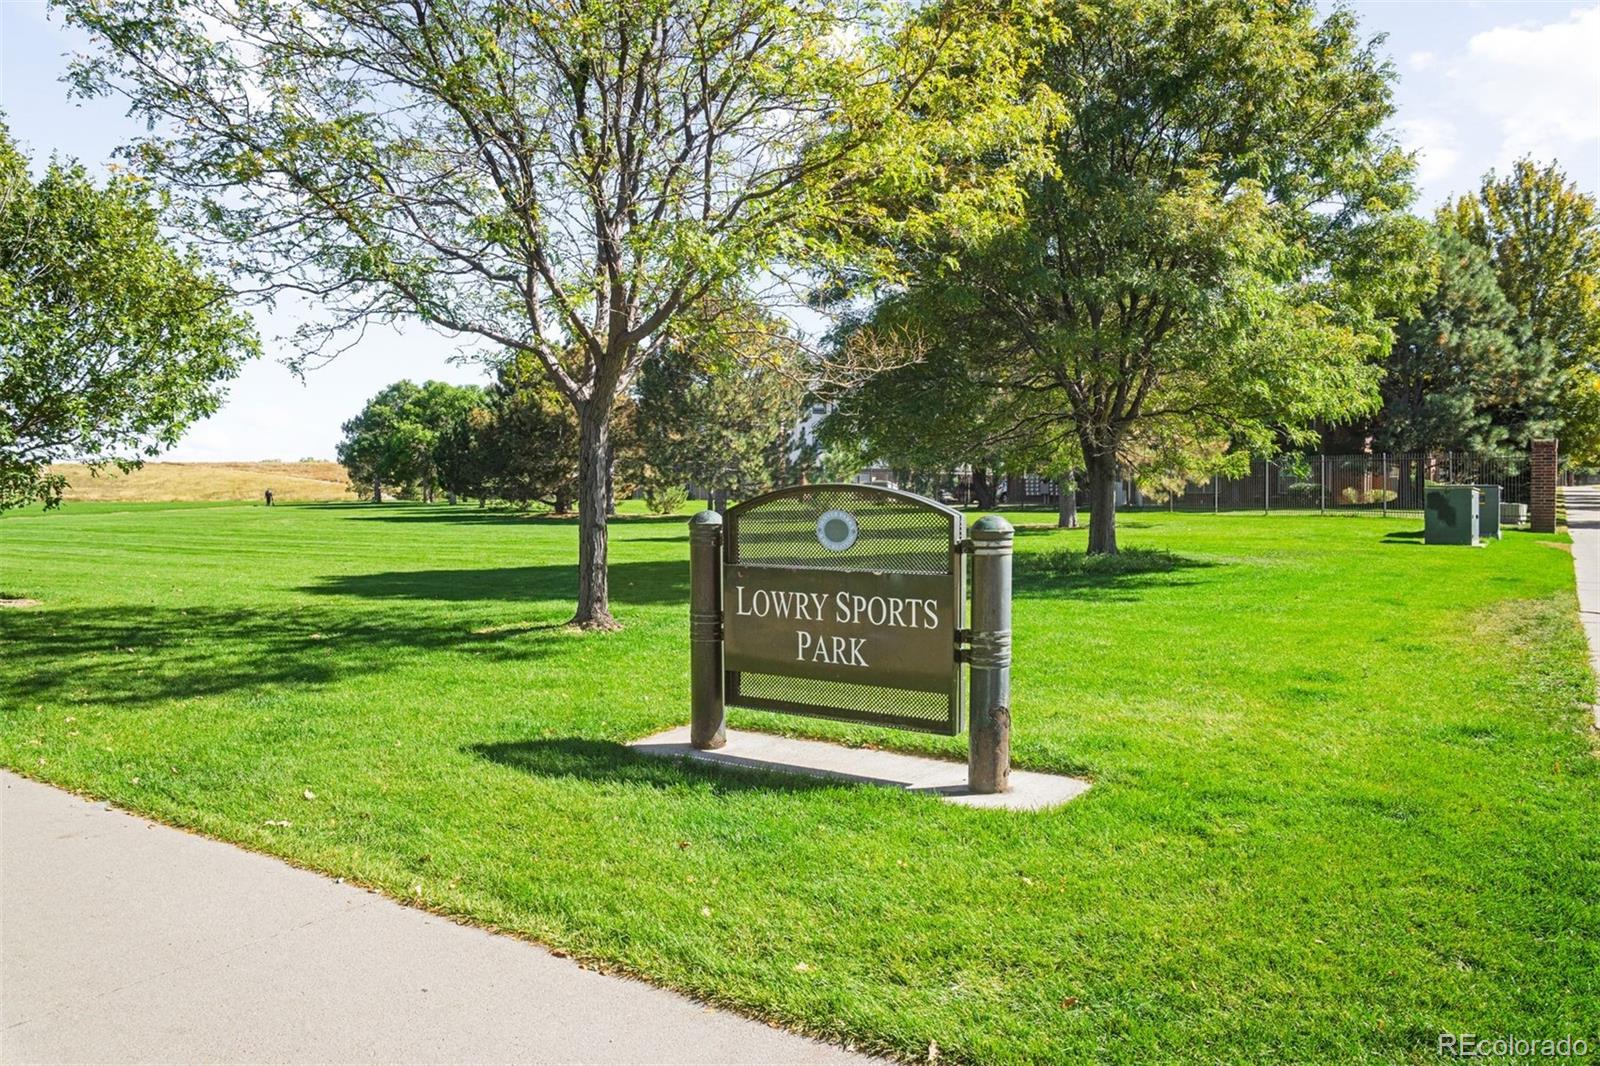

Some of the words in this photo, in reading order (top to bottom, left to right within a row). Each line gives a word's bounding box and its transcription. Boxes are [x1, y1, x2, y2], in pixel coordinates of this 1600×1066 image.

[736, 586, 829, 621] LOWRY
[836, 591, 939, 629] SPORTS
[796, 631, 869, 667] PARK
